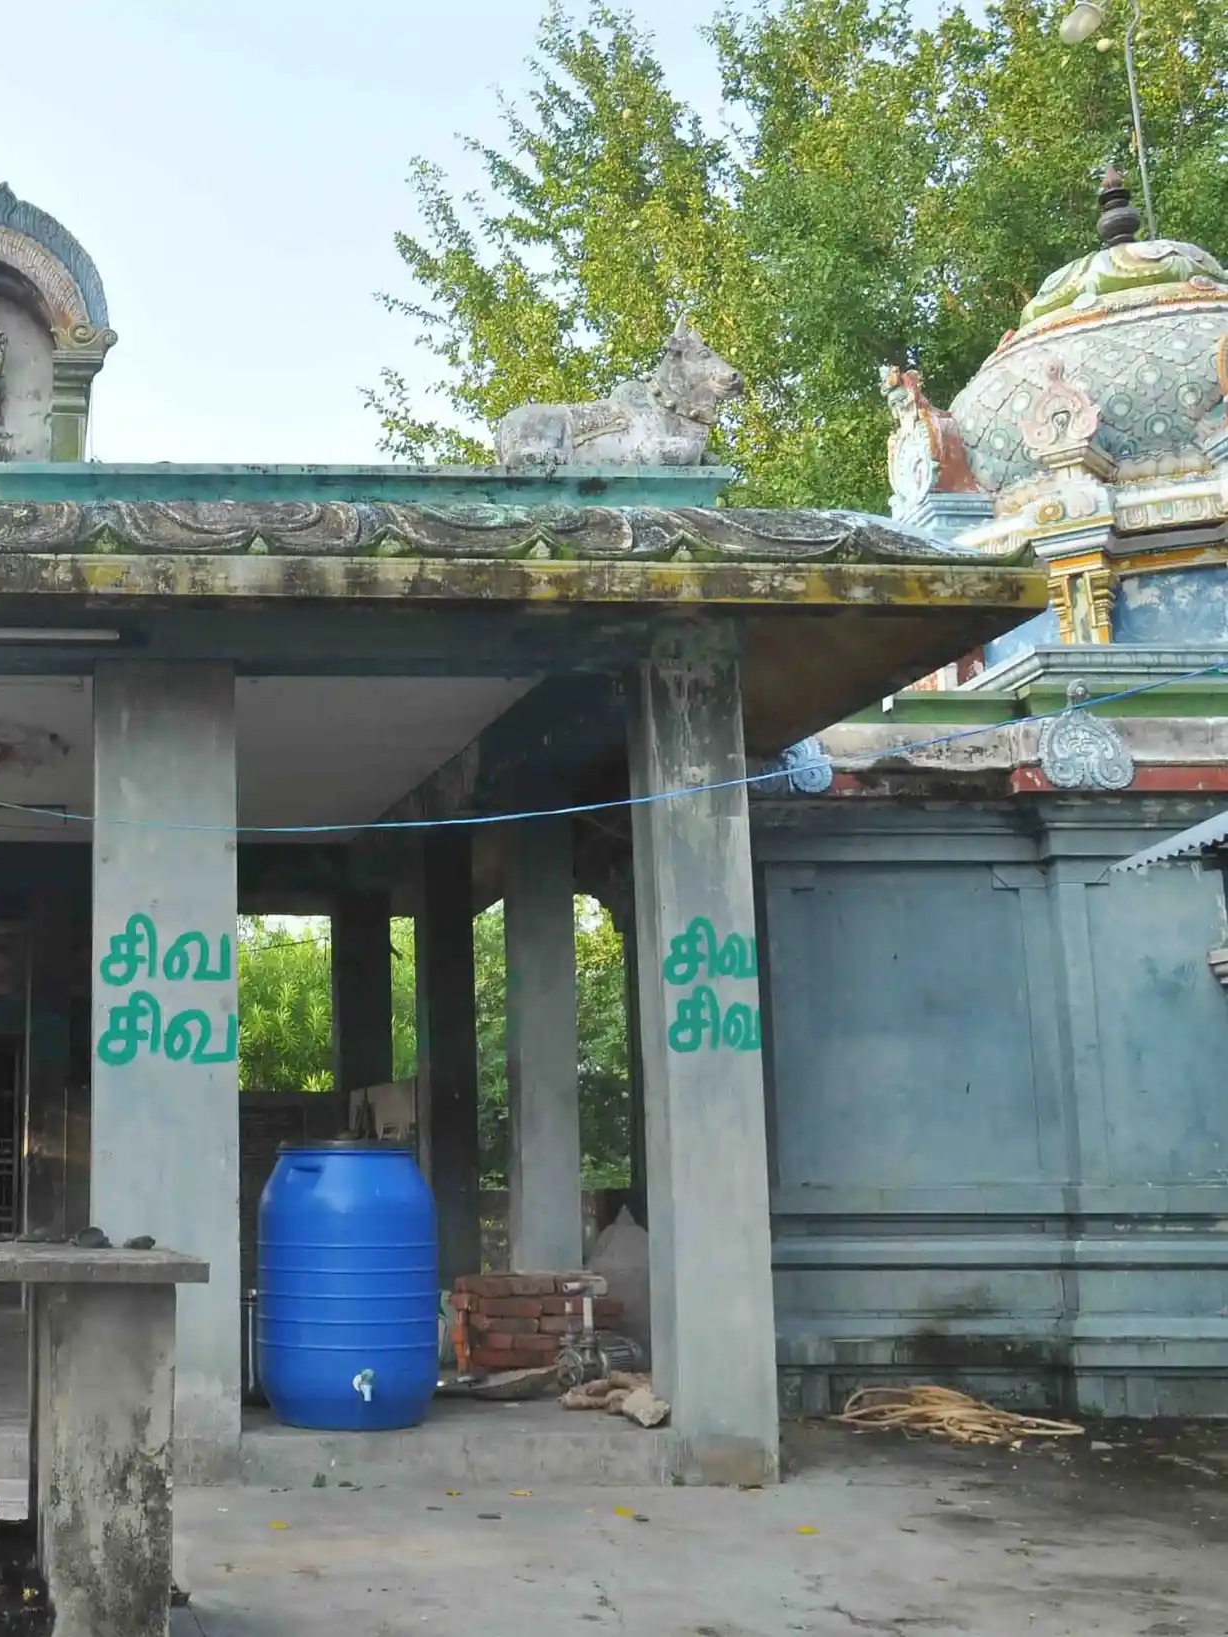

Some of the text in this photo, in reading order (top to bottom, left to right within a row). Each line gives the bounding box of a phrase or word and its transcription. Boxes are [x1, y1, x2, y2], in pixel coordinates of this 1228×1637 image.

[100, 913, 232, 986] சிவ
[663, 915, 758, 985] சிவ
[97, 990, 239, 1067] சிவ
[668, 985, 762, 1053] சிவ
